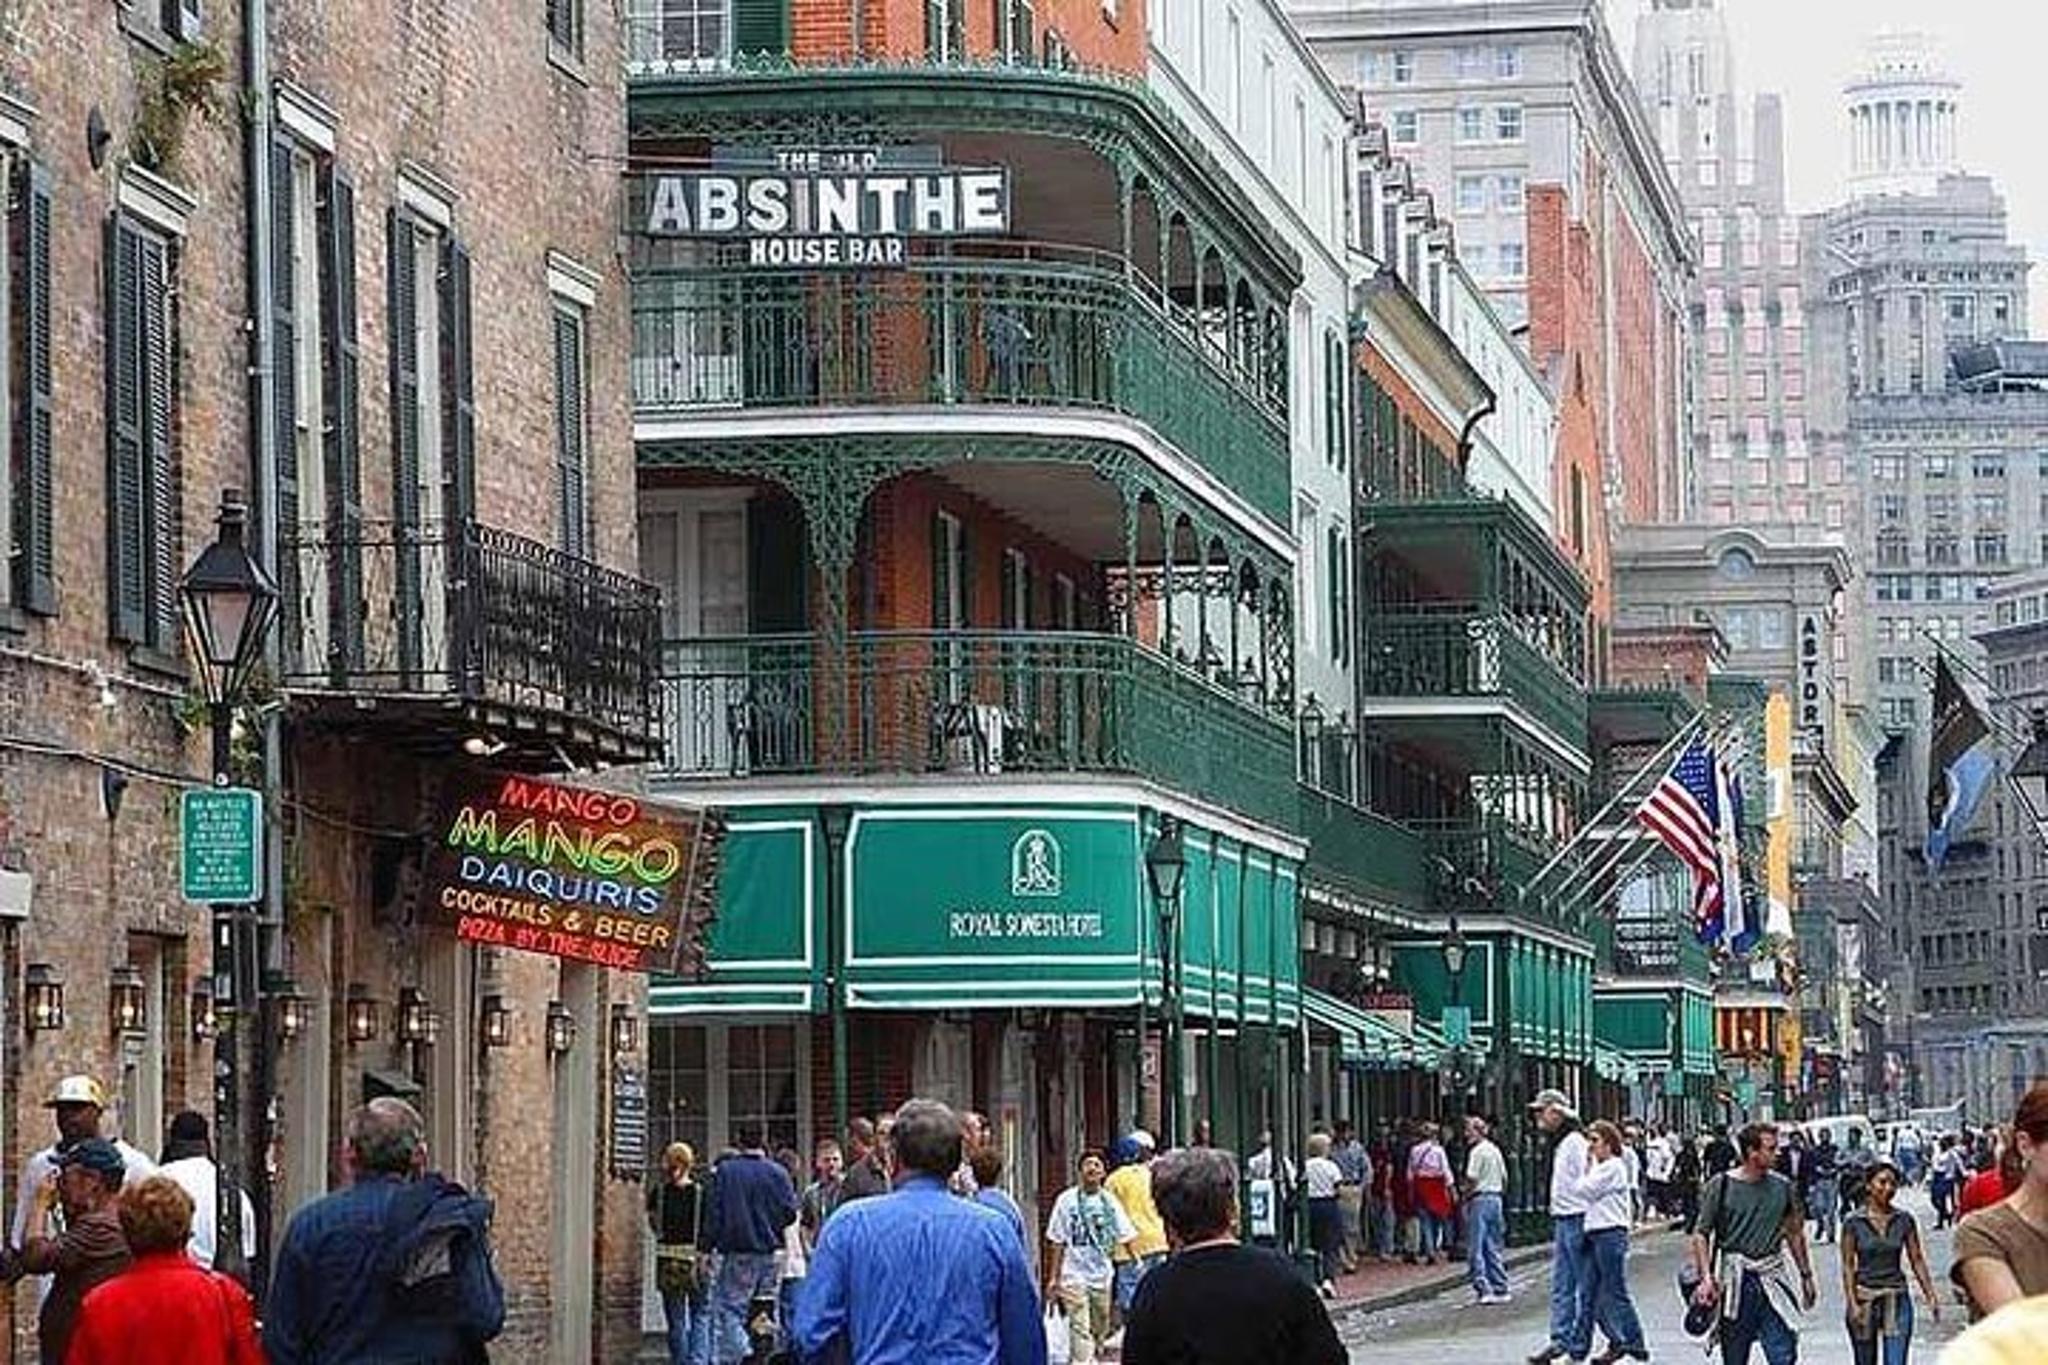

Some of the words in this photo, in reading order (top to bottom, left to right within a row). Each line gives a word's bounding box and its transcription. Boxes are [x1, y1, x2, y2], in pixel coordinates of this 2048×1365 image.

[779, 153, 820, 171] THE
[647, 174, 1004, 233] ABSINTHE
[750, 239, 841, 266] HOUSE
[849, 237, 903, 264] BAR
[1803, 616, 1818, 722] ASTOR
[501, 775, 636, 825] MANGO
[448, 806, 680, 883] MANGO
[460, 856, 661, 915] DAIQUIRIS
[441, 886, 552, 926] COCKTAILS
[563, 911, 584, 931] &
[594, 917, 670, 948] BEER
[458, 915, 505, 941] PIZZA
[517, 928, 541, 948] BY
[549, 932, 584, 956] THE
[590, 943, 641, 967] SLICE
[950, 912, 1002, 937] ROYAL
